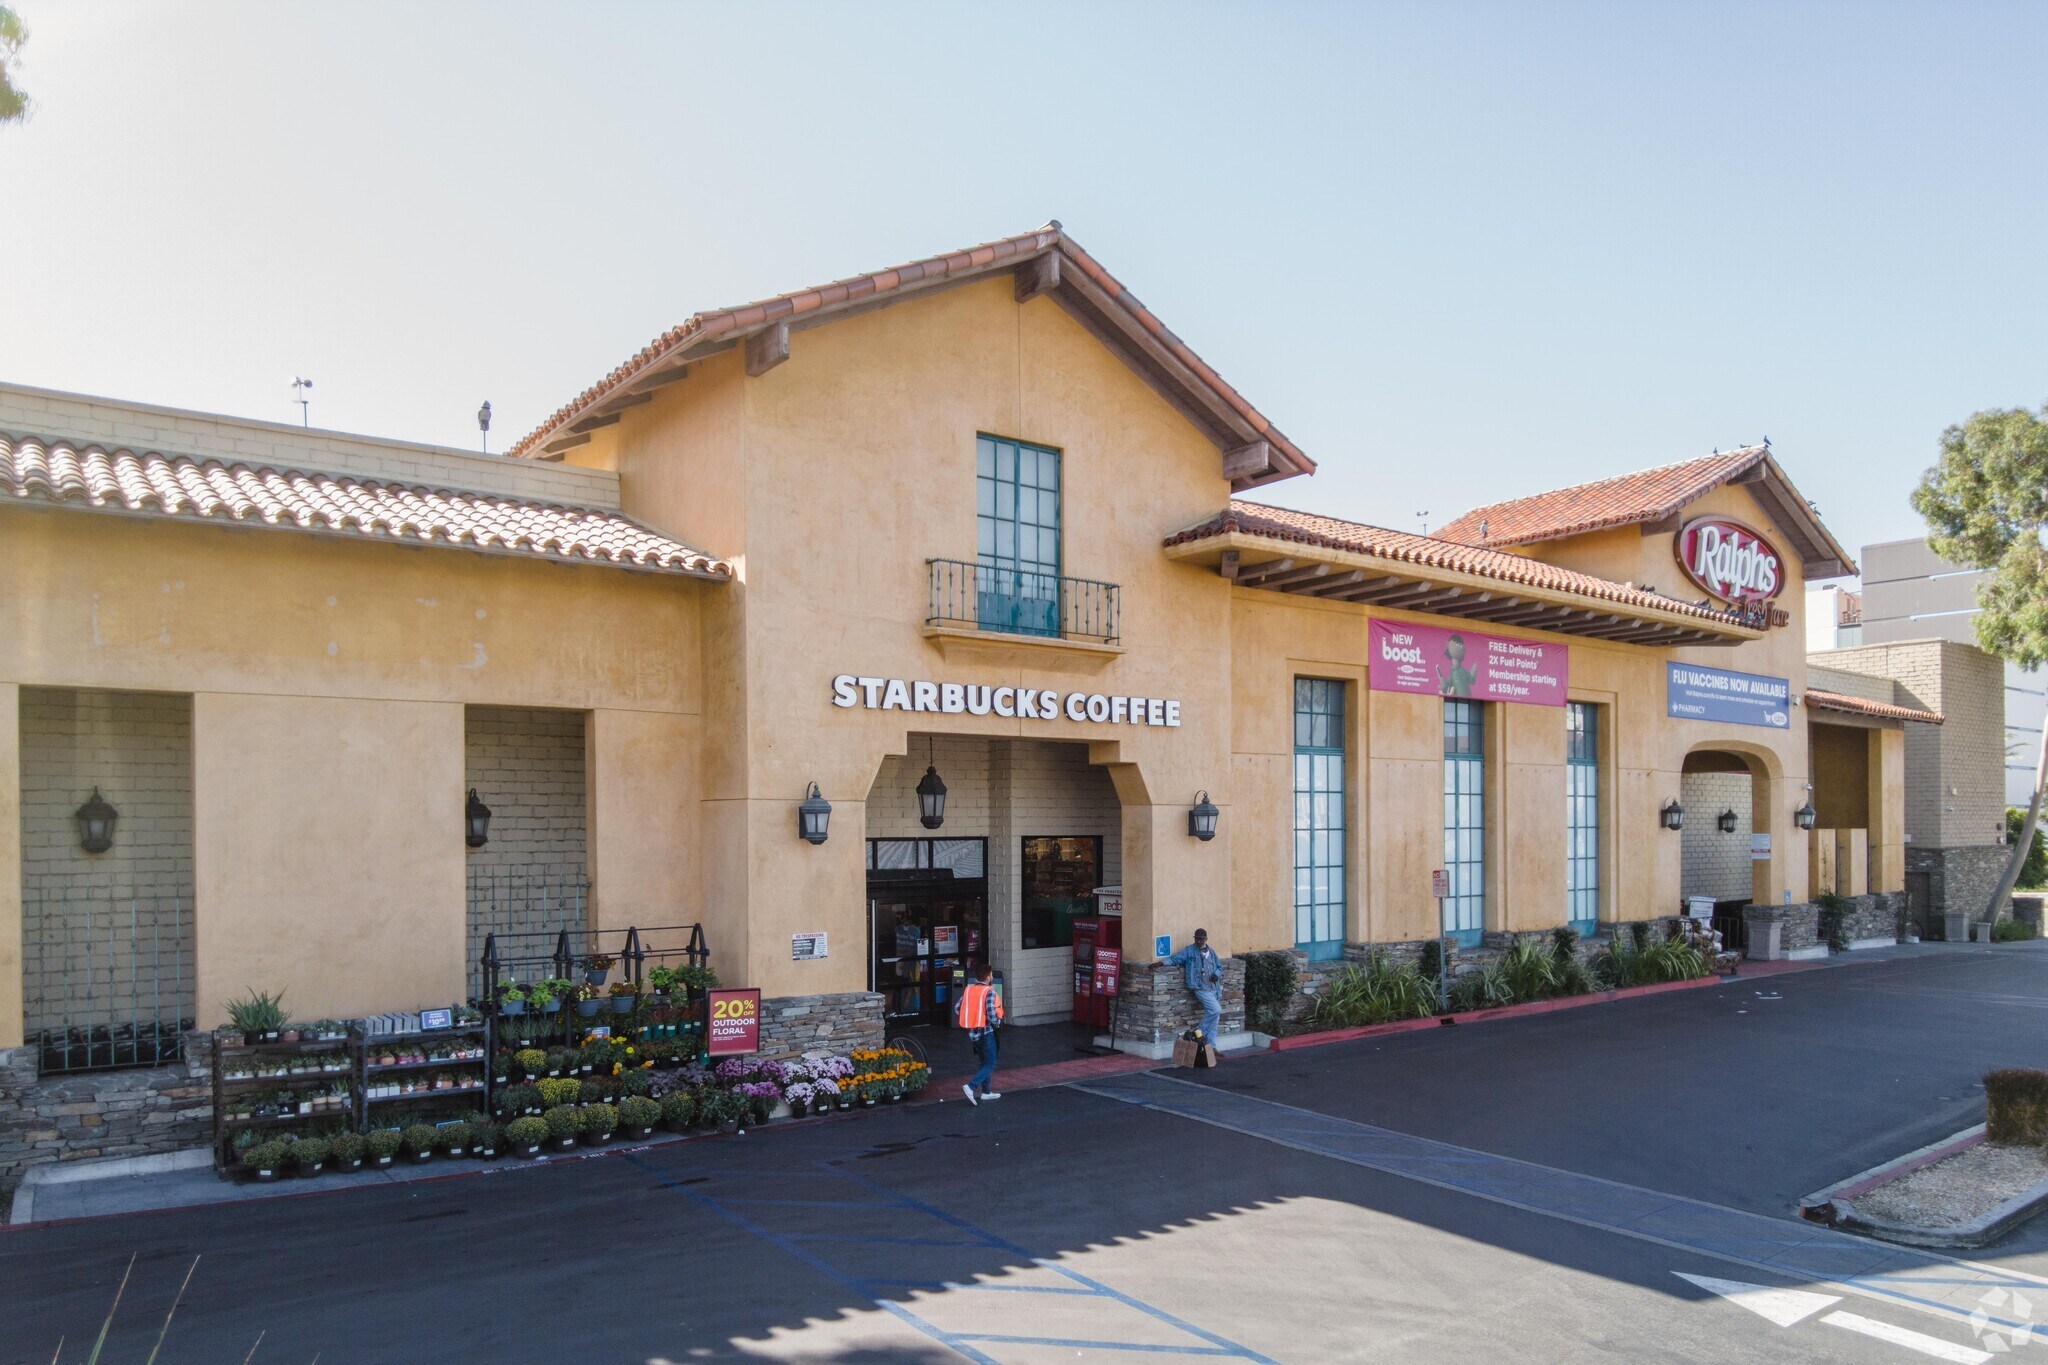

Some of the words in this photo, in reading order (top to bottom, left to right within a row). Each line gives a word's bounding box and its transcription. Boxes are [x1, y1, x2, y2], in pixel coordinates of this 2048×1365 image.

[1697, 525, 1777, 597] Ralphs
[1392, 633, 1413, 645] NEW
[1382, 639, 1421, 663] boost
[1489, 641, 1508, 653] FREE
[1509, 644, 1536, 658] Delivery
[1537, 648, 1543, 657] &
[1489, 655, 1498, 665] 2X
[1500, 656, 1515, 667] Fuel
[1489, 669, 1530, 684] Membership
[1531, 675, 1557, 687] starting
[1673, 669, 1687, 684] FLU
[1688, 671, 1729, 690] VACCINES
[1730, 678, 1748, 693] NOW
[1750, 681, 1786, 698] AVAILABLE
[1489, 683, 1496, 692] at
[1497, 683, 1530, 696] $59/year.
[832, 674, 1059, 720] STARBUCKS
[1064, 692, 1181, 727] COFFEE
[1678, 703, 1705, 714] PHARMACY
[713, 1018, 755, 1027] OUTDOOR
[713, 1027, 745, 1035] FLORAL
